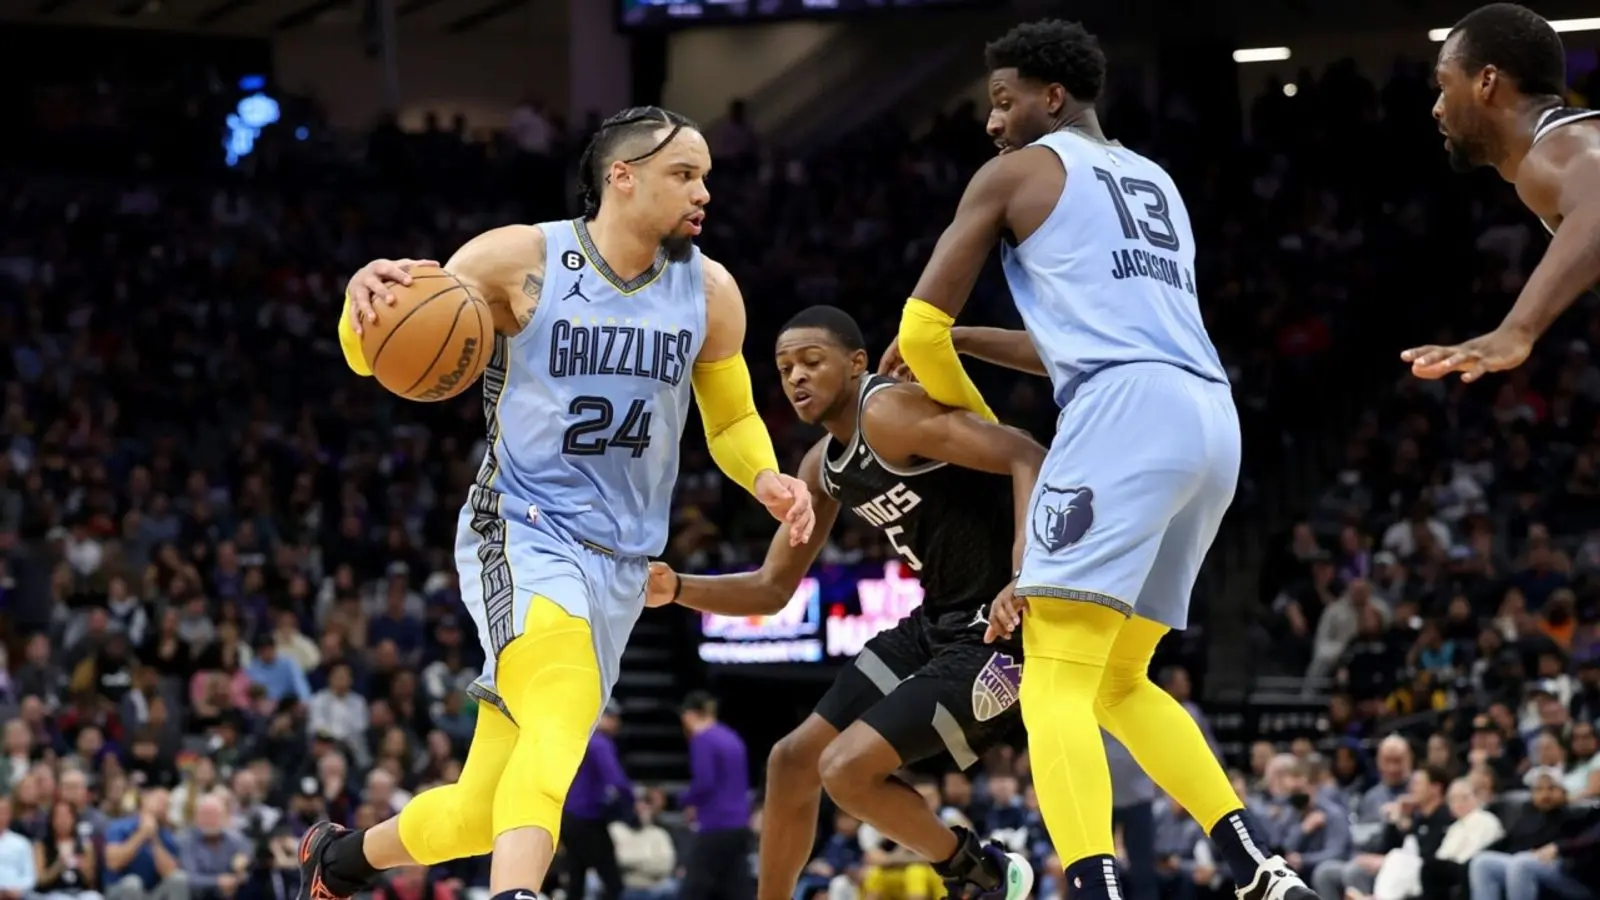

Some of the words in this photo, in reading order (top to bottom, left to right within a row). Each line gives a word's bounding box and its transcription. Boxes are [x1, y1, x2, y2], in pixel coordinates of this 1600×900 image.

[1092, 166, 1180, 252] 13
[567, 253, 581, 270] 6
[1111, 248, 1182, 290] JACKSON
[1184, 267, 1196, 298] J
[549, 319, 692, 387] GRIZZLIES
[562, 395, 652, 458] 24
[885, 525, 923, 571] 5
[979, 669, 1013, 709] KINGS
